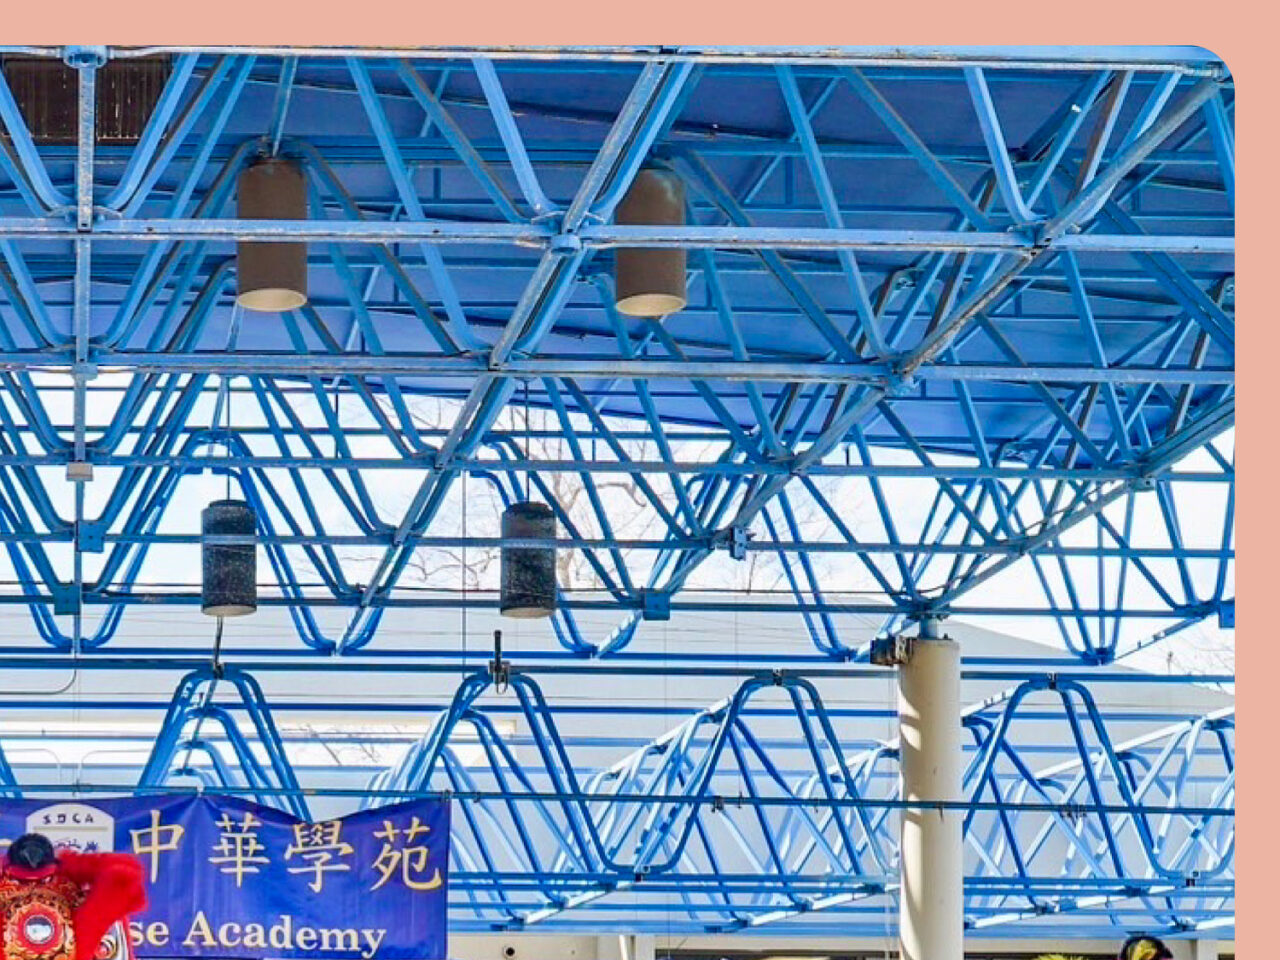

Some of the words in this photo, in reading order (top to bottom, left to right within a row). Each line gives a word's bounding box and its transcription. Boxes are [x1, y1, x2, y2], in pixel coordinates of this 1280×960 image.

[42, 813, 95, 825] SDCA
[129, 809, 442, 893] 中華學苑
[182, 911, 388, 957] Academy
